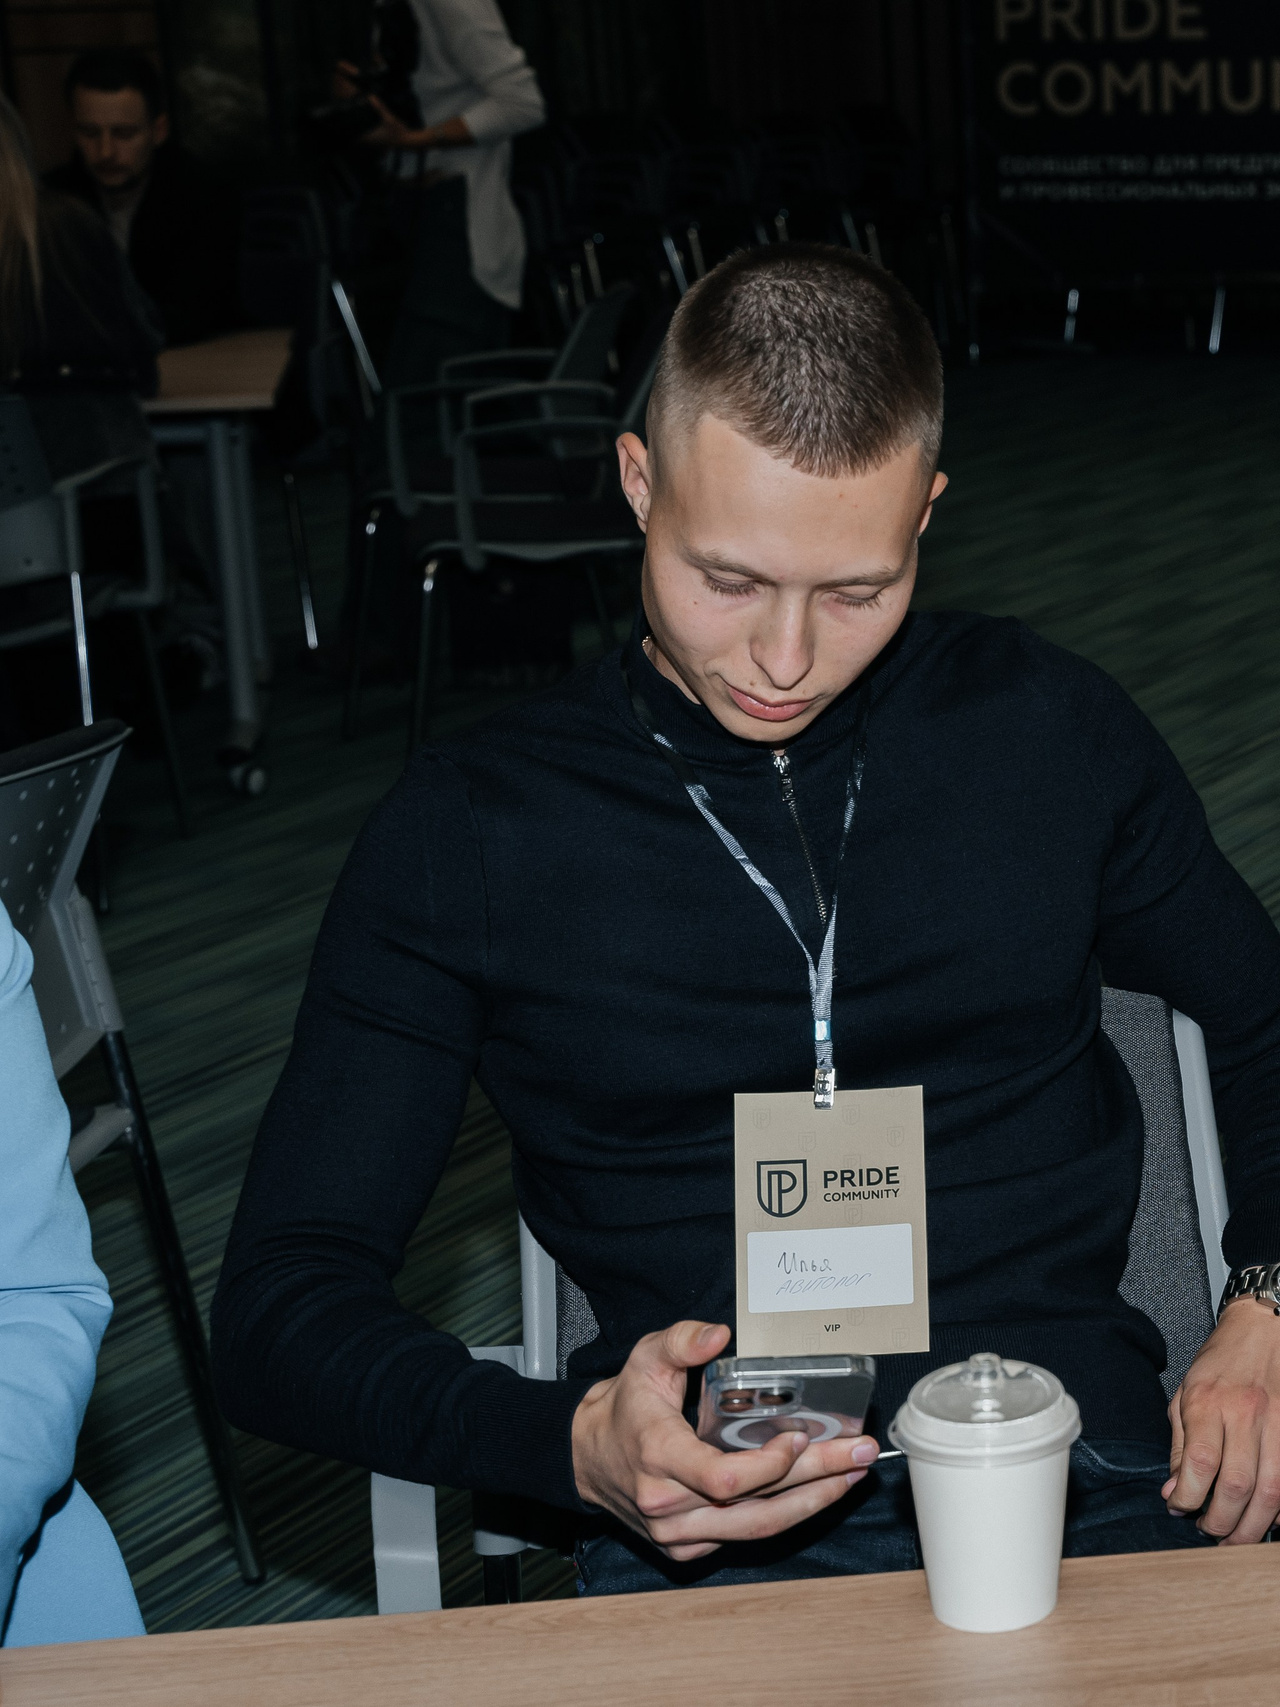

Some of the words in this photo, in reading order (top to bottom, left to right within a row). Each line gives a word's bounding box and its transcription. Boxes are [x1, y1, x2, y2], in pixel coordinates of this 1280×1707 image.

[996, 0, 1207, 41] PRIDE
[823, 1166, 900, 1189] PRIDE
[823, 1188, 900, 1203] COMMUNITY
[824, 1324, 841, 1332] VIP
